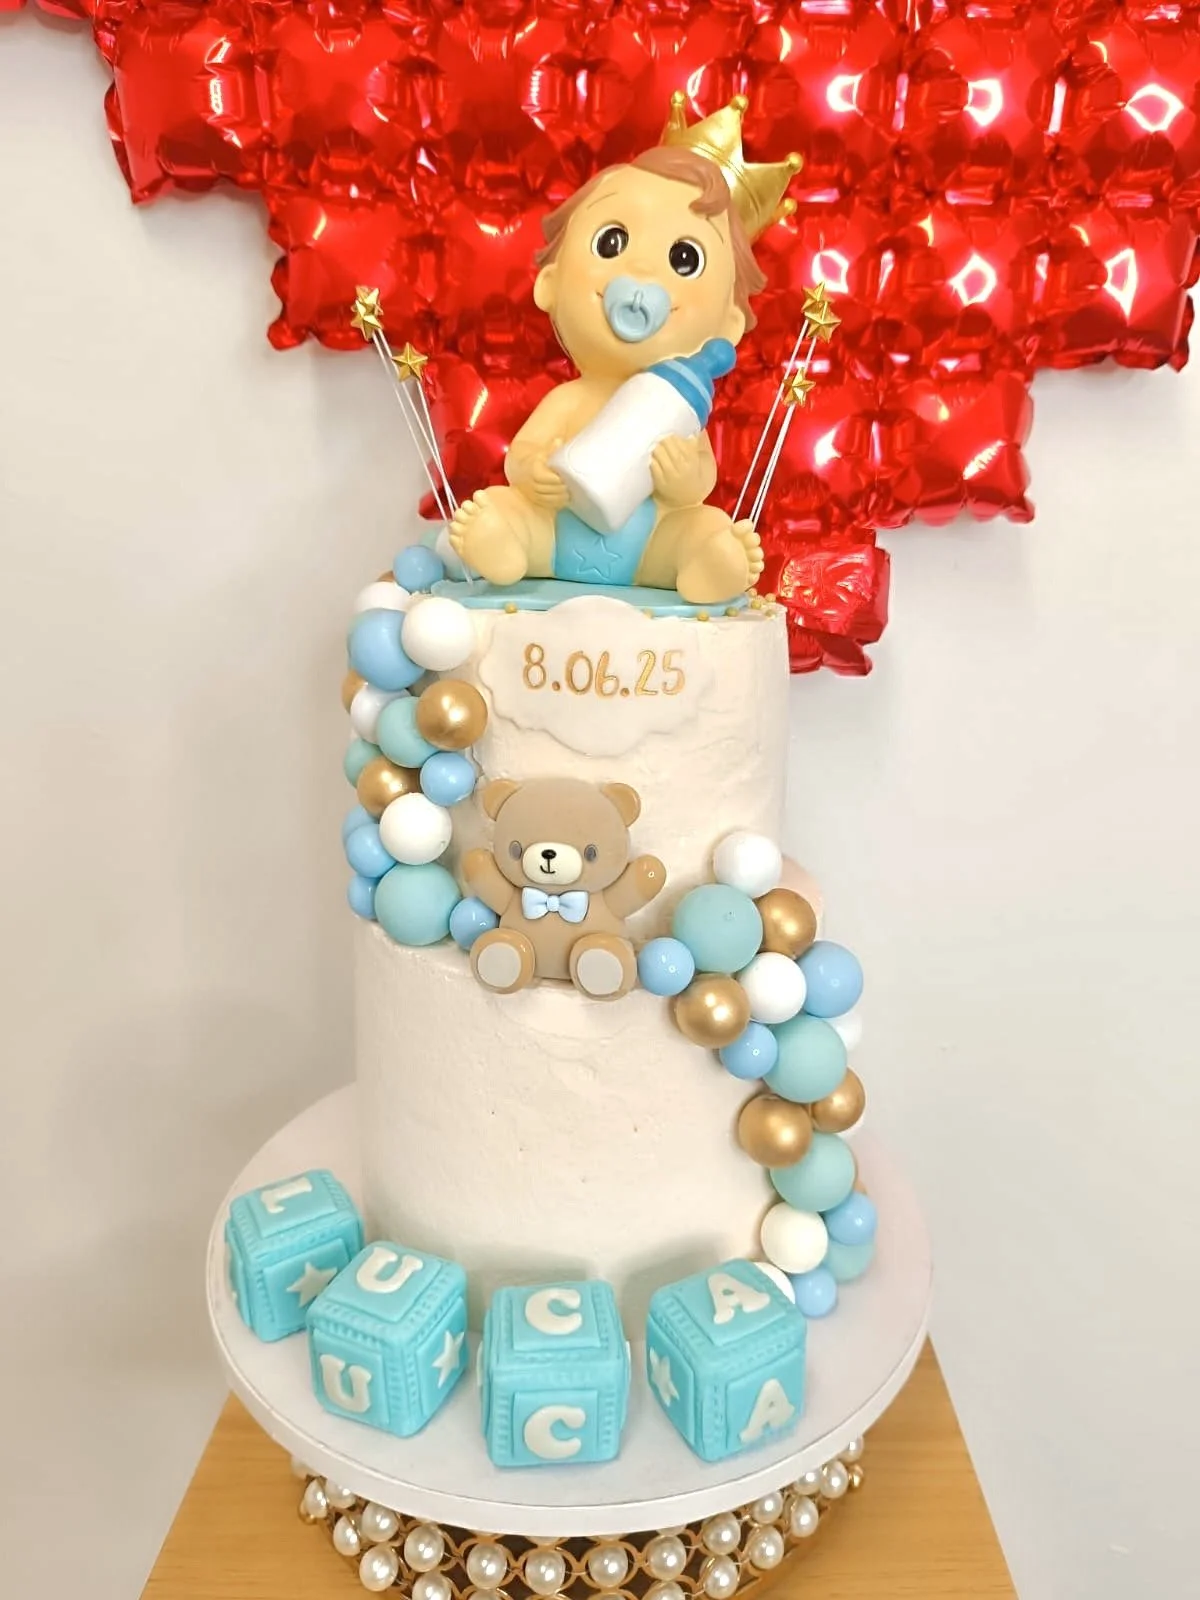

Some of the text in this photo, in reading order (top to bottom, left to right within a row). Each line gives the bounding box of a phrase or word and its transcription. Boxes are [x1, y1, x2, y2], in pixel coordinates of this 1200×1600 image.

[522, 643, 686, 697] 8.06.25
[356, 1247, 423, 1293] U
[525, 1288, 582, 1335] C
[707, 1273, 771, 1324] A
[320, 1354, 371, 1413] U
[740, 1378, 796, 1443] A
[524, 1405, 586, 1460] C
